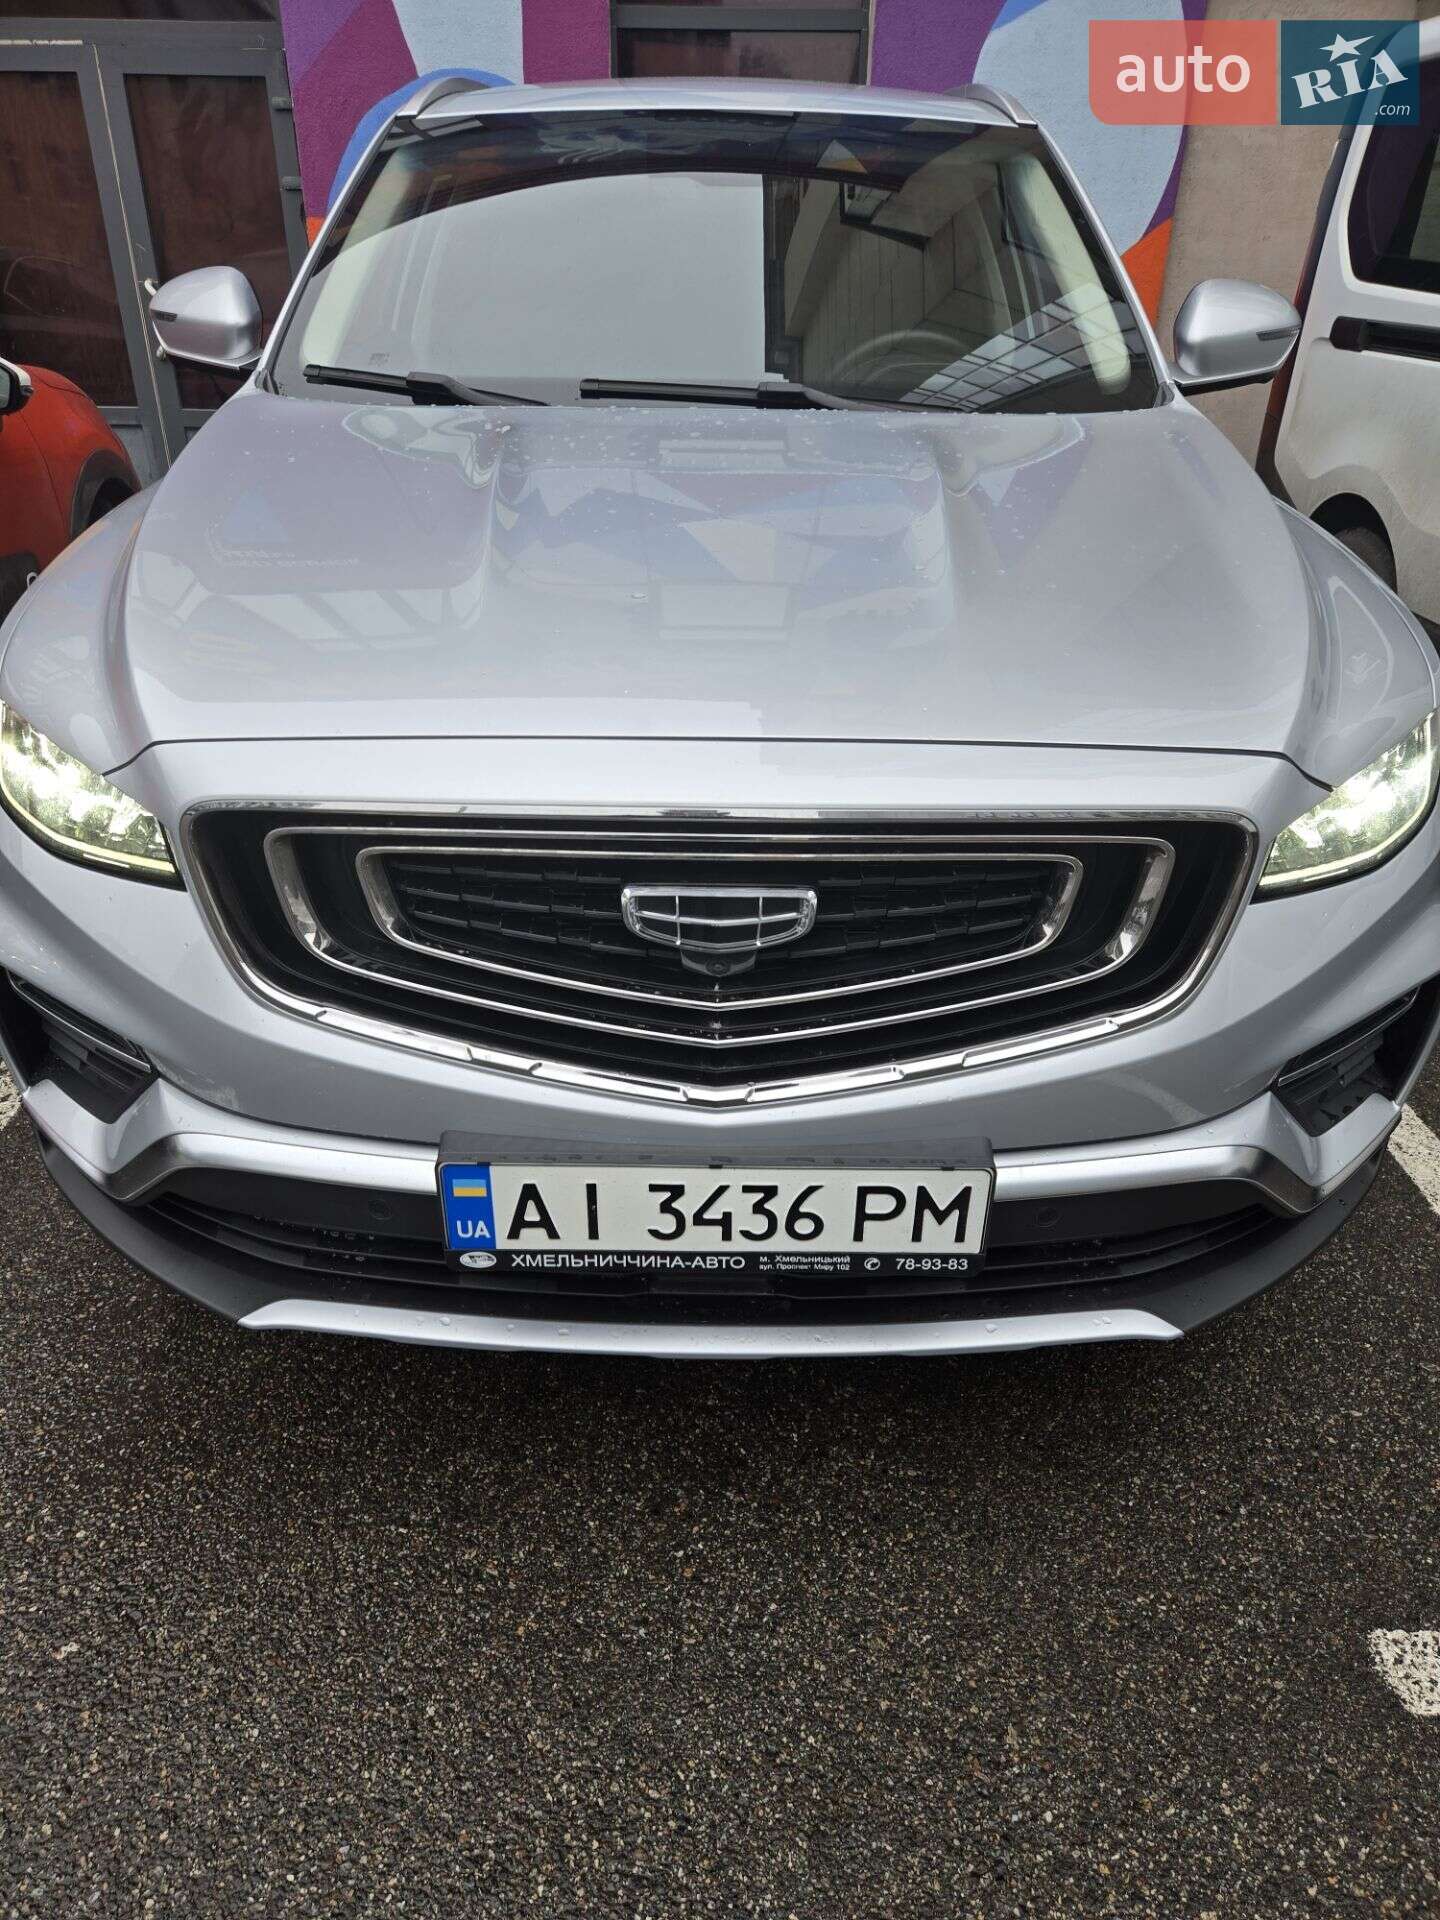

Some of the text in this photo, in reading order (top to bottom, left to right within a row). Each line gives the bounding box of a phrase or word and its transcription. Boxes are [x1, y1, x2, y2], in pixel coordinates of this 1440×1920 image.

[647, 1184, 825, 1242] 3436
[852, 1185, 973, 1243] PM
[456, 1220, 491, 1239] UA
[511, 1254, 746, 1269] ХМЕЛЬНИЧЧИНА-АВТО
[896, 1258, 968, 1270] 78-93-83
